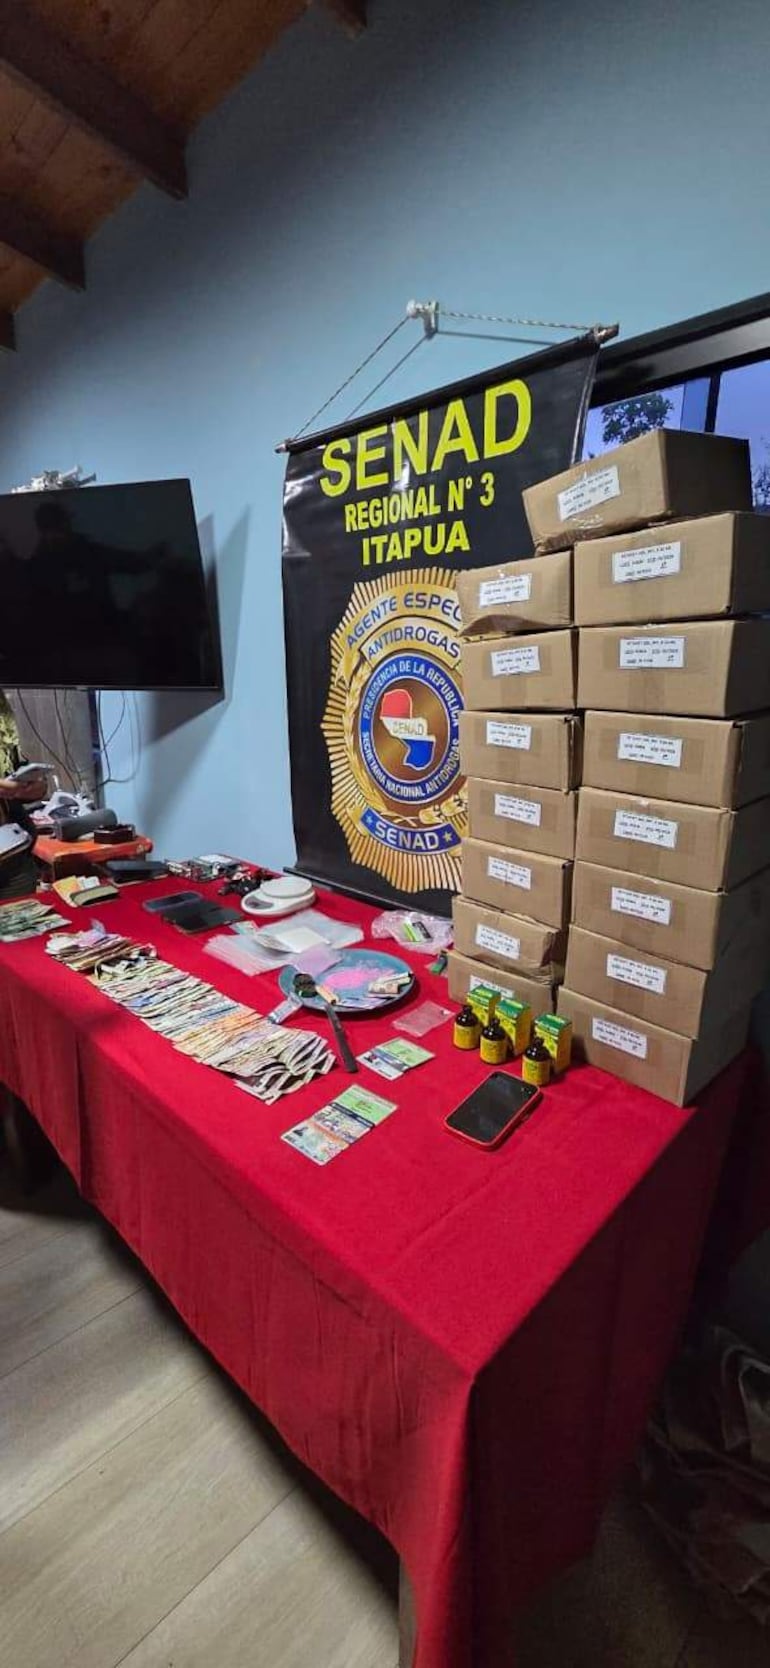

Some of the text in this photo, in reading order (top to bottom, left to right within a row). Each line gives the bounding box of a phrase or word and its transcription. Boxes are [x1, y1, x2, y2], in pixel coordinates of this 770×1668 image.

[320, 379, 532, 497] SENAD
[345, 485, 441, 532] REGIONAL
[480, 472, 495, 507] 3
[362, 520, 470, 566] ITAPUA
[346, 596, 398, 648] AGENTE
[367, 626, 460, 660] ANTIDROGAS
[363, 663, 398, 720] PRESIDENCIA
[400, 661, 411, 672] DE
[413, 661, 425, 675] LA
[362, 732, 386, 785] SECRETARIA
[385, 782, 426, 797] NACIONAL
[375, 821, 439, 850] SENAD
